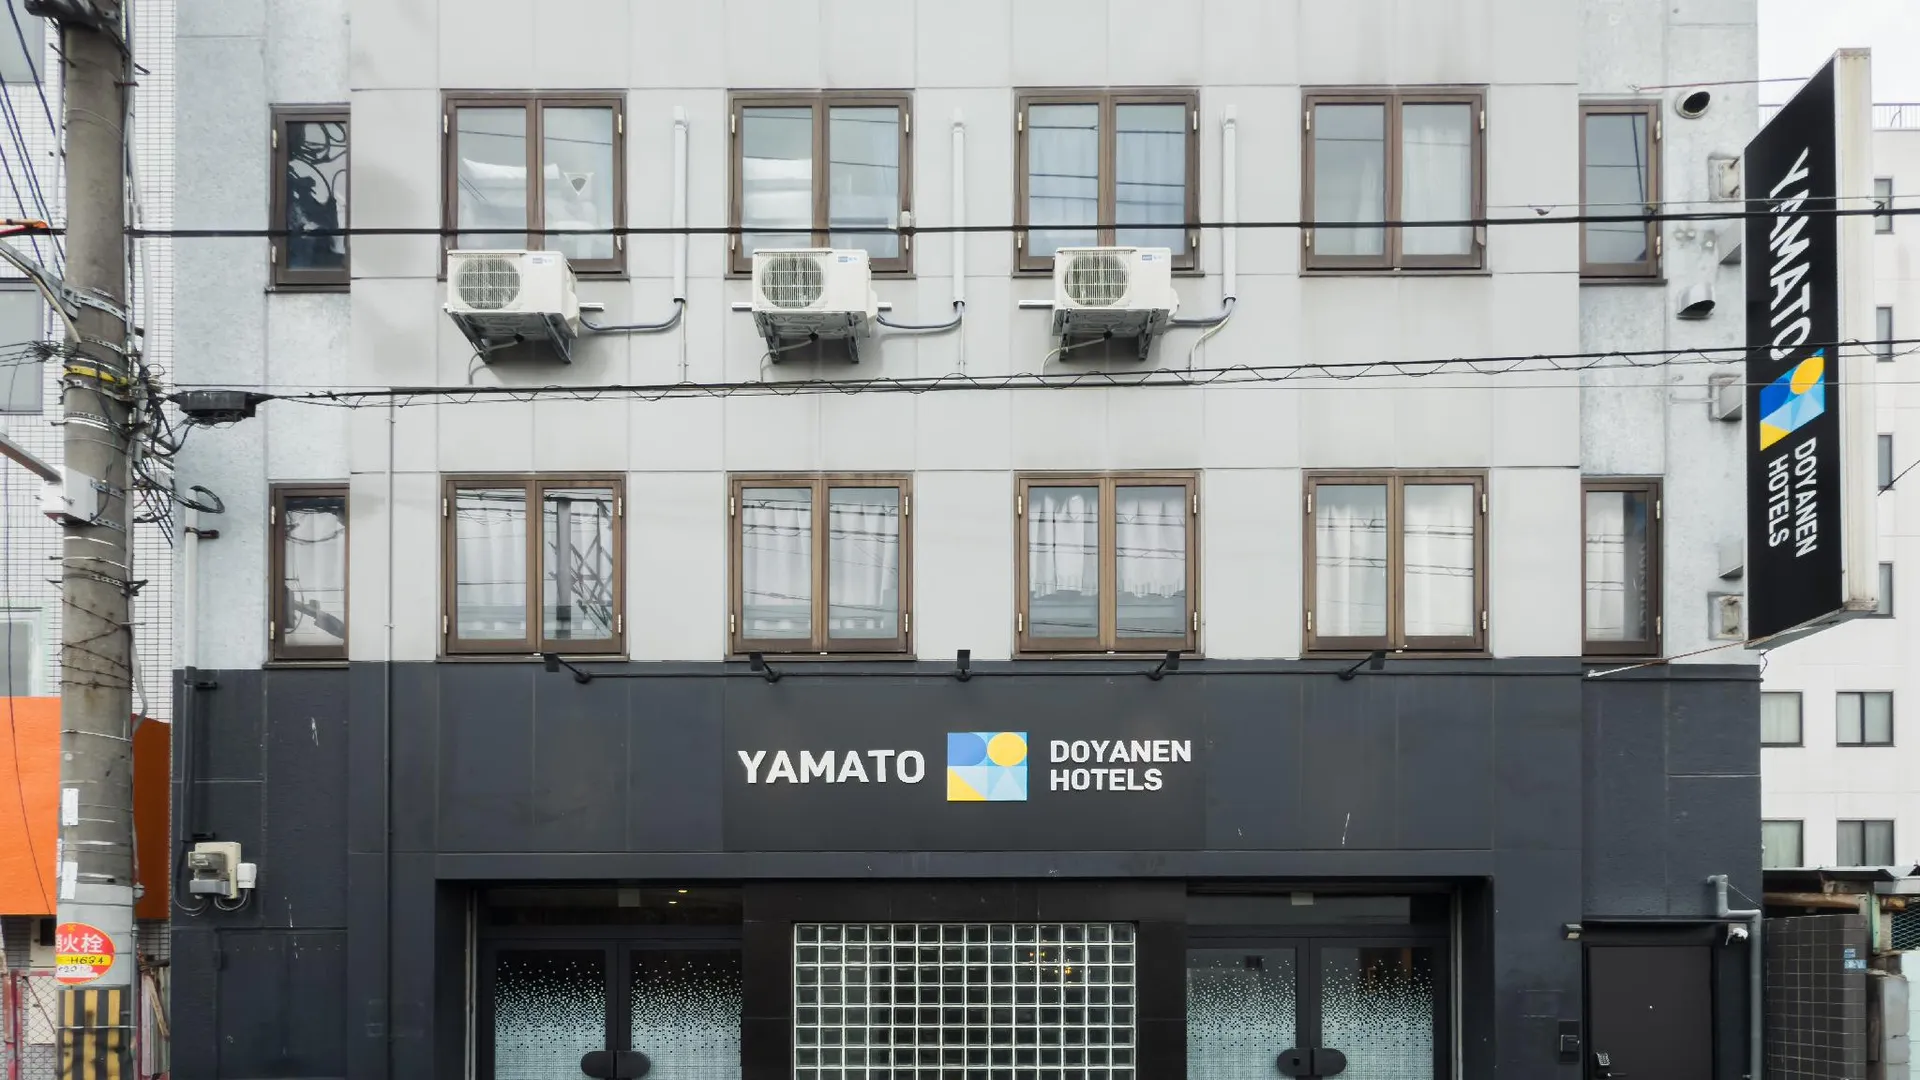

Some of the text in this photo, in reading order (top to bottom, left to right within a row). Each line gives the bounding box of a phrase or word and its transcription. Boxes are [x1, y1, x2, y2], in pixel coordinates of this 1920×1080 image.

[1769, 146, 1811, 360] YAMATO
[1768, 453, 1789, 547] HOTELS
[1794, 437, 1817, 557] DOYANEN
[737, 749, 926, 784] YAMATO
[1050, 739, 1192, 763] DOYANEN
[1050, 768, 1163, 791] HOTELS
